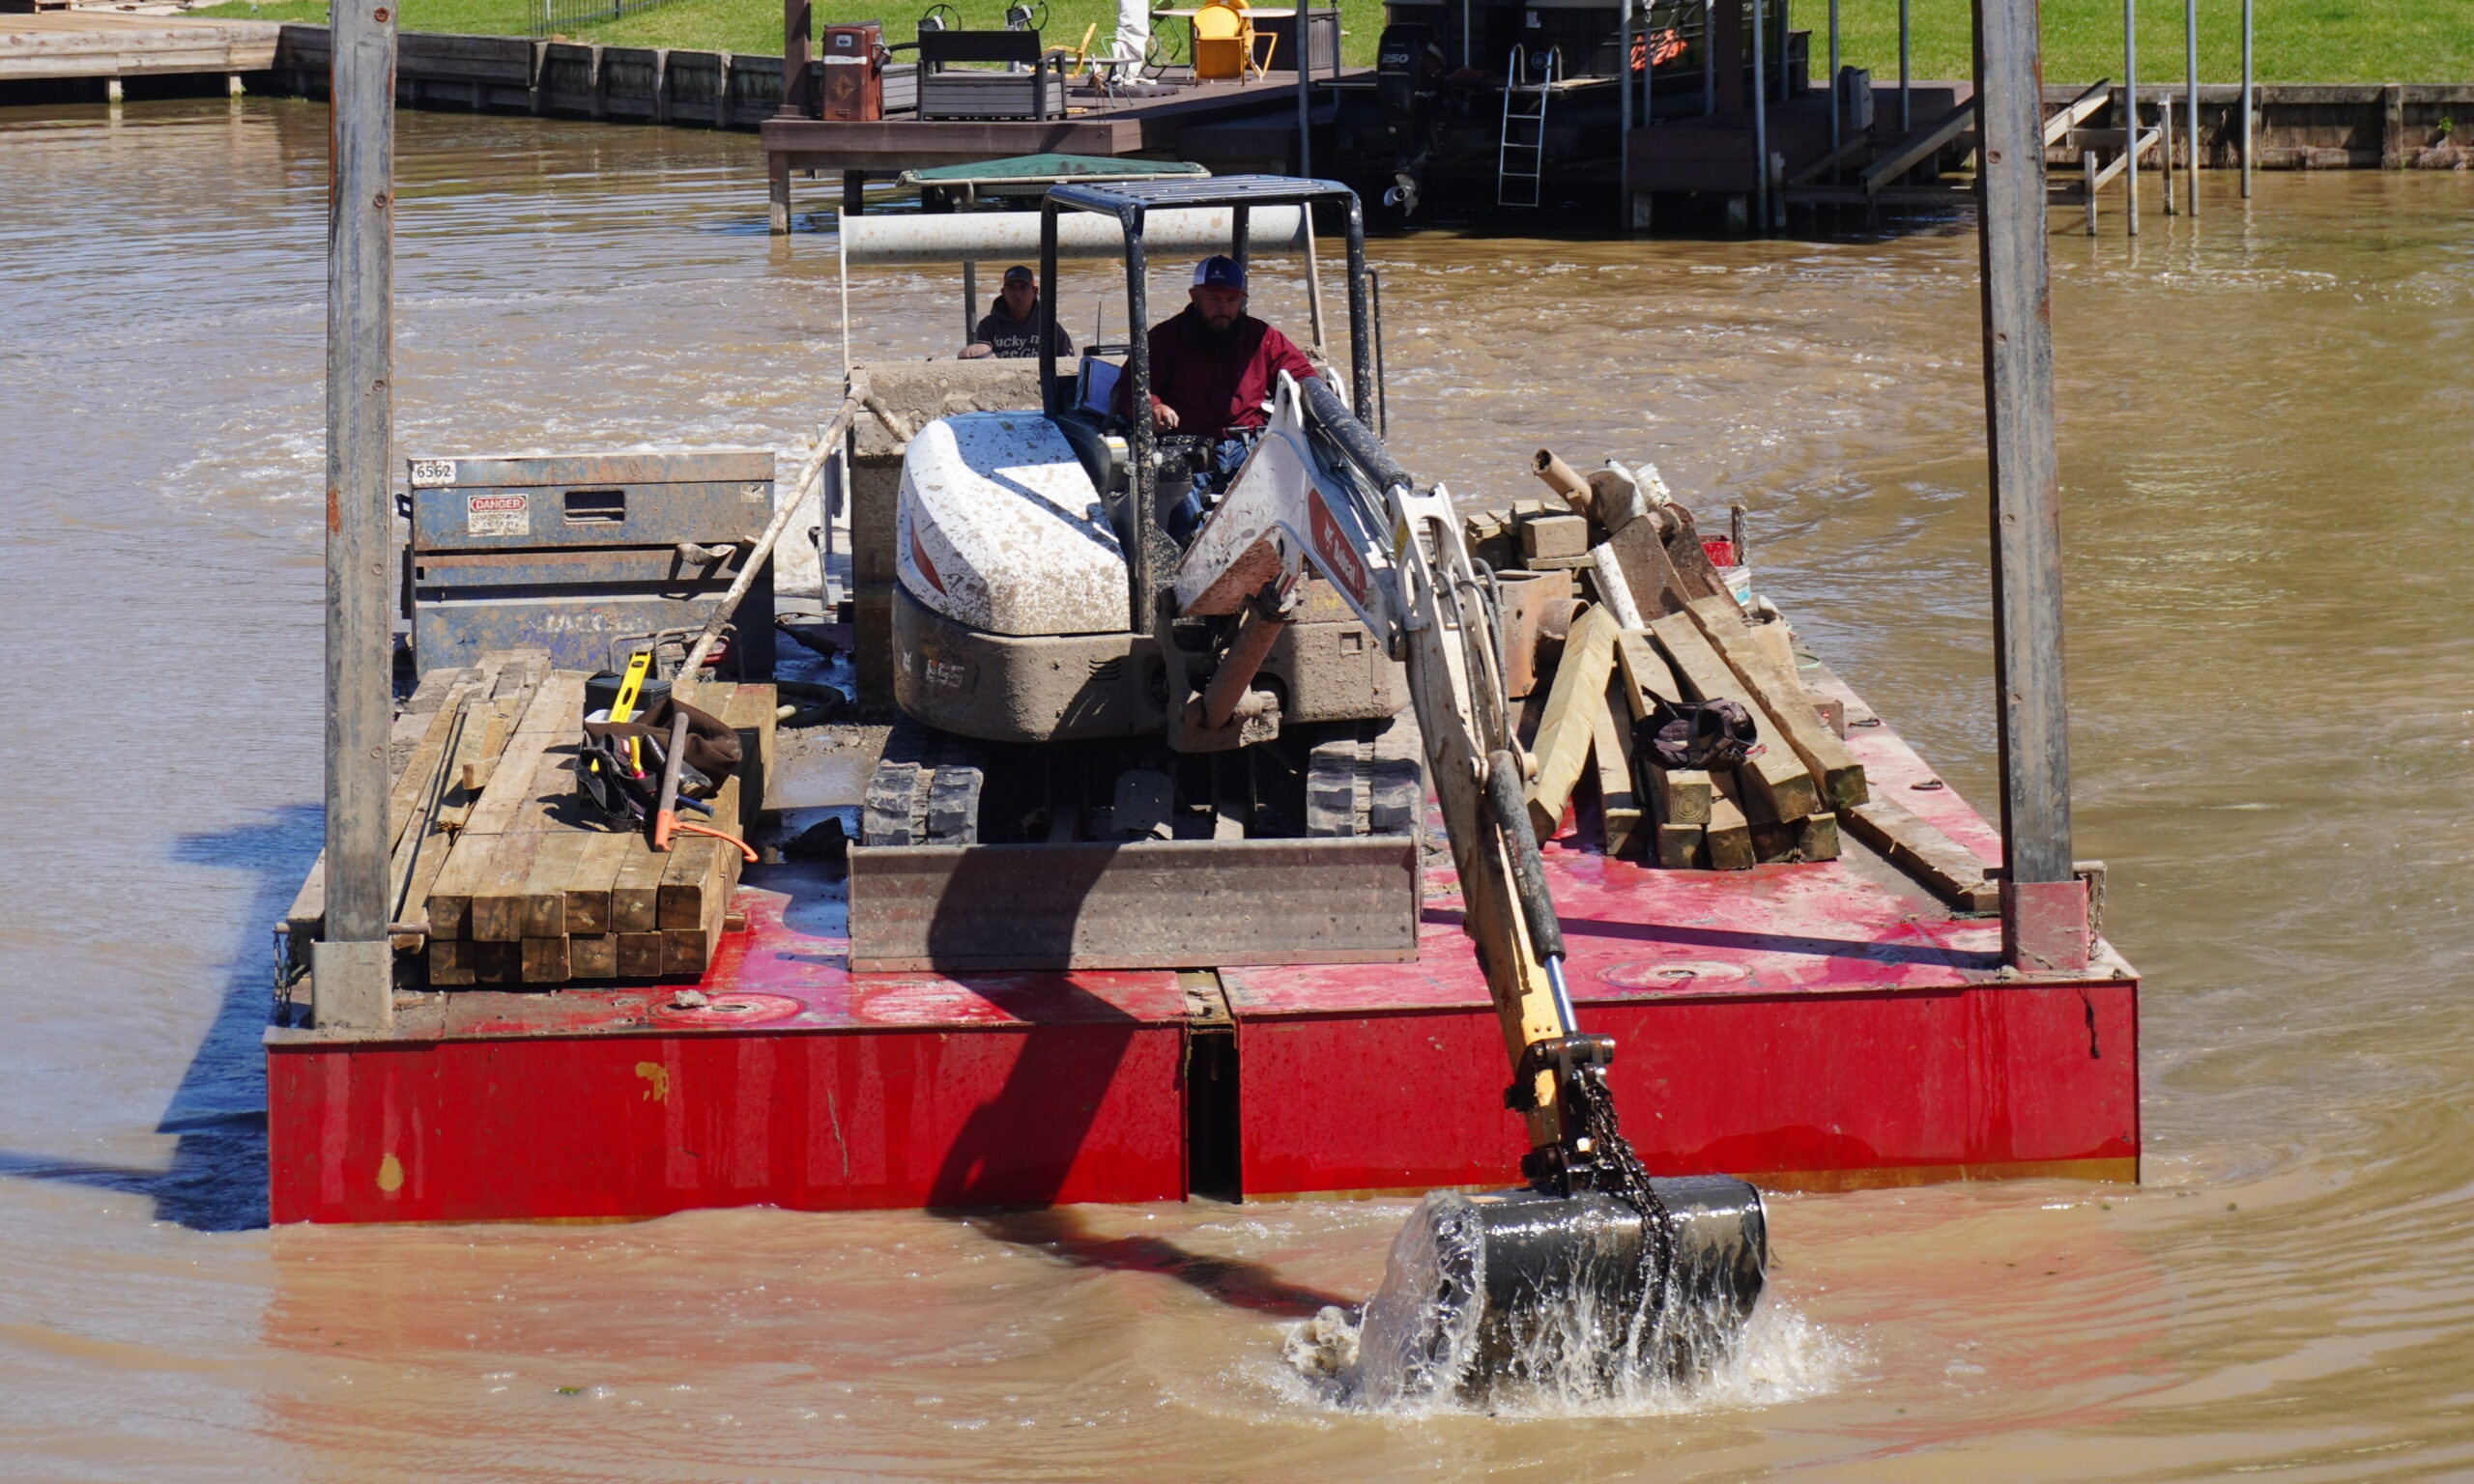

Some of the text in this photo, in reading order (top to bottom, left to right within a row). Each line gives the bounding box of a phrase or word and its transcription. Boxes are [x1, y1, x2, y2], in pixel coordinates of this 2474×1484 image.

[1381, 53, 1409, 64] 250
[417, 465, 451, 478] 6562
[475, 499, 522, 510] DANGER
